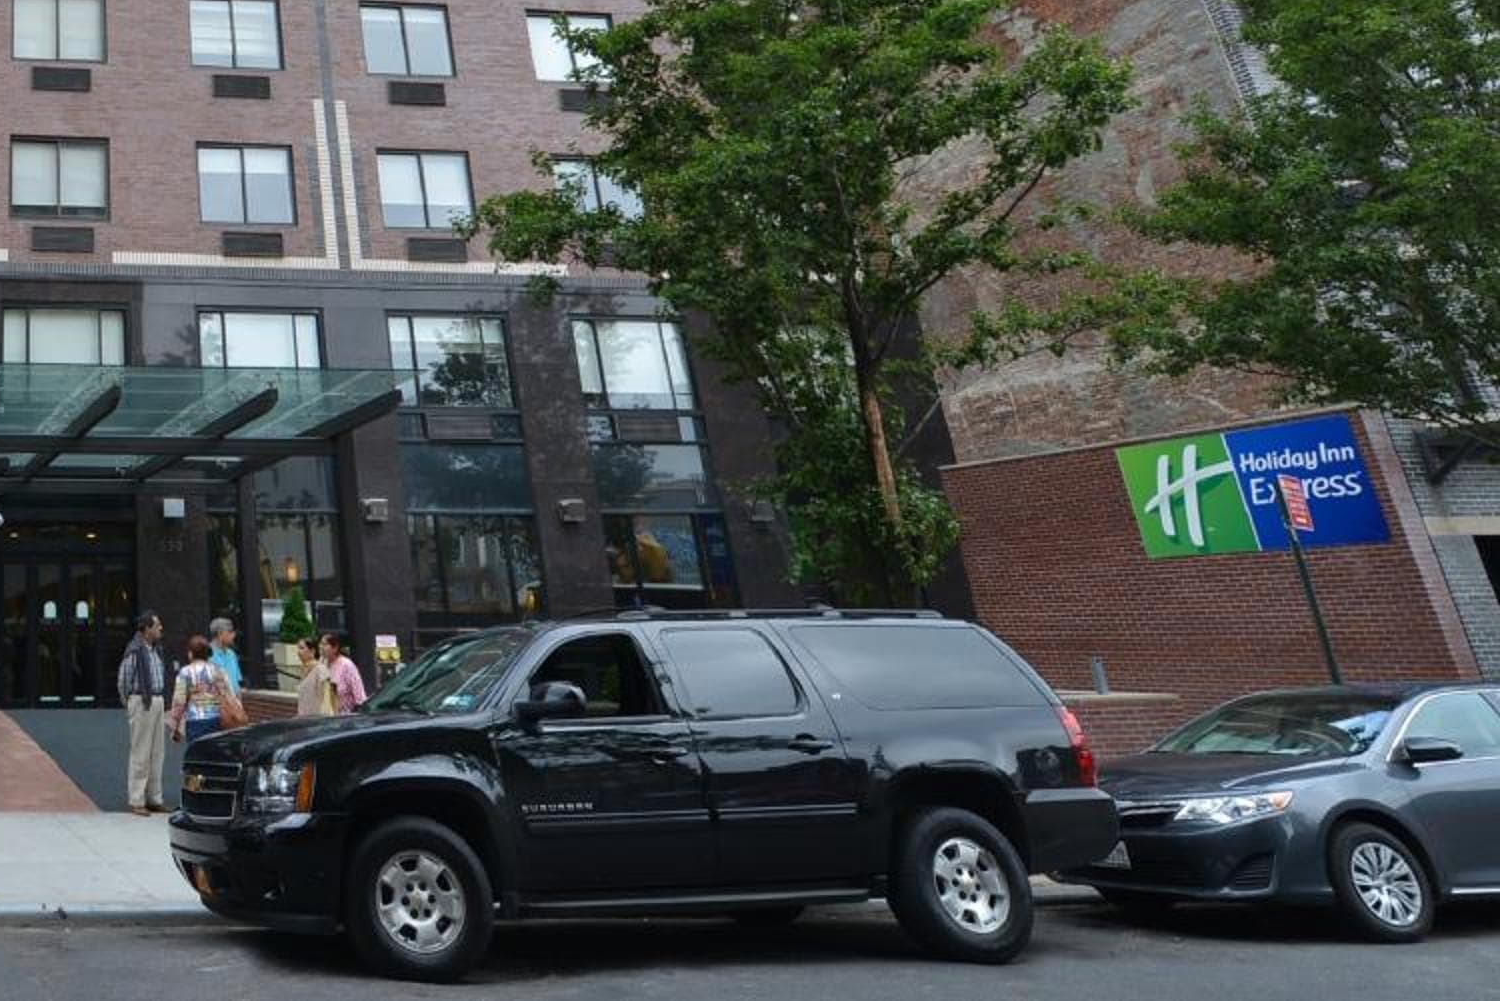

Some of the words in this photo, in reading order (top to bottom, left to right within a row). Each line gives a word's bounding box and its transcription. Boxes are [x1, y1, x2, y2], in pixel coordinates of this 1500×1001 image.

[1240, 446, 1317, 472] Holiday
[1320, 442, 1355, 464] Inn
[1251, 472, 1362, 505] Exress
[521, 802, 594, 813] SUBURBAN
